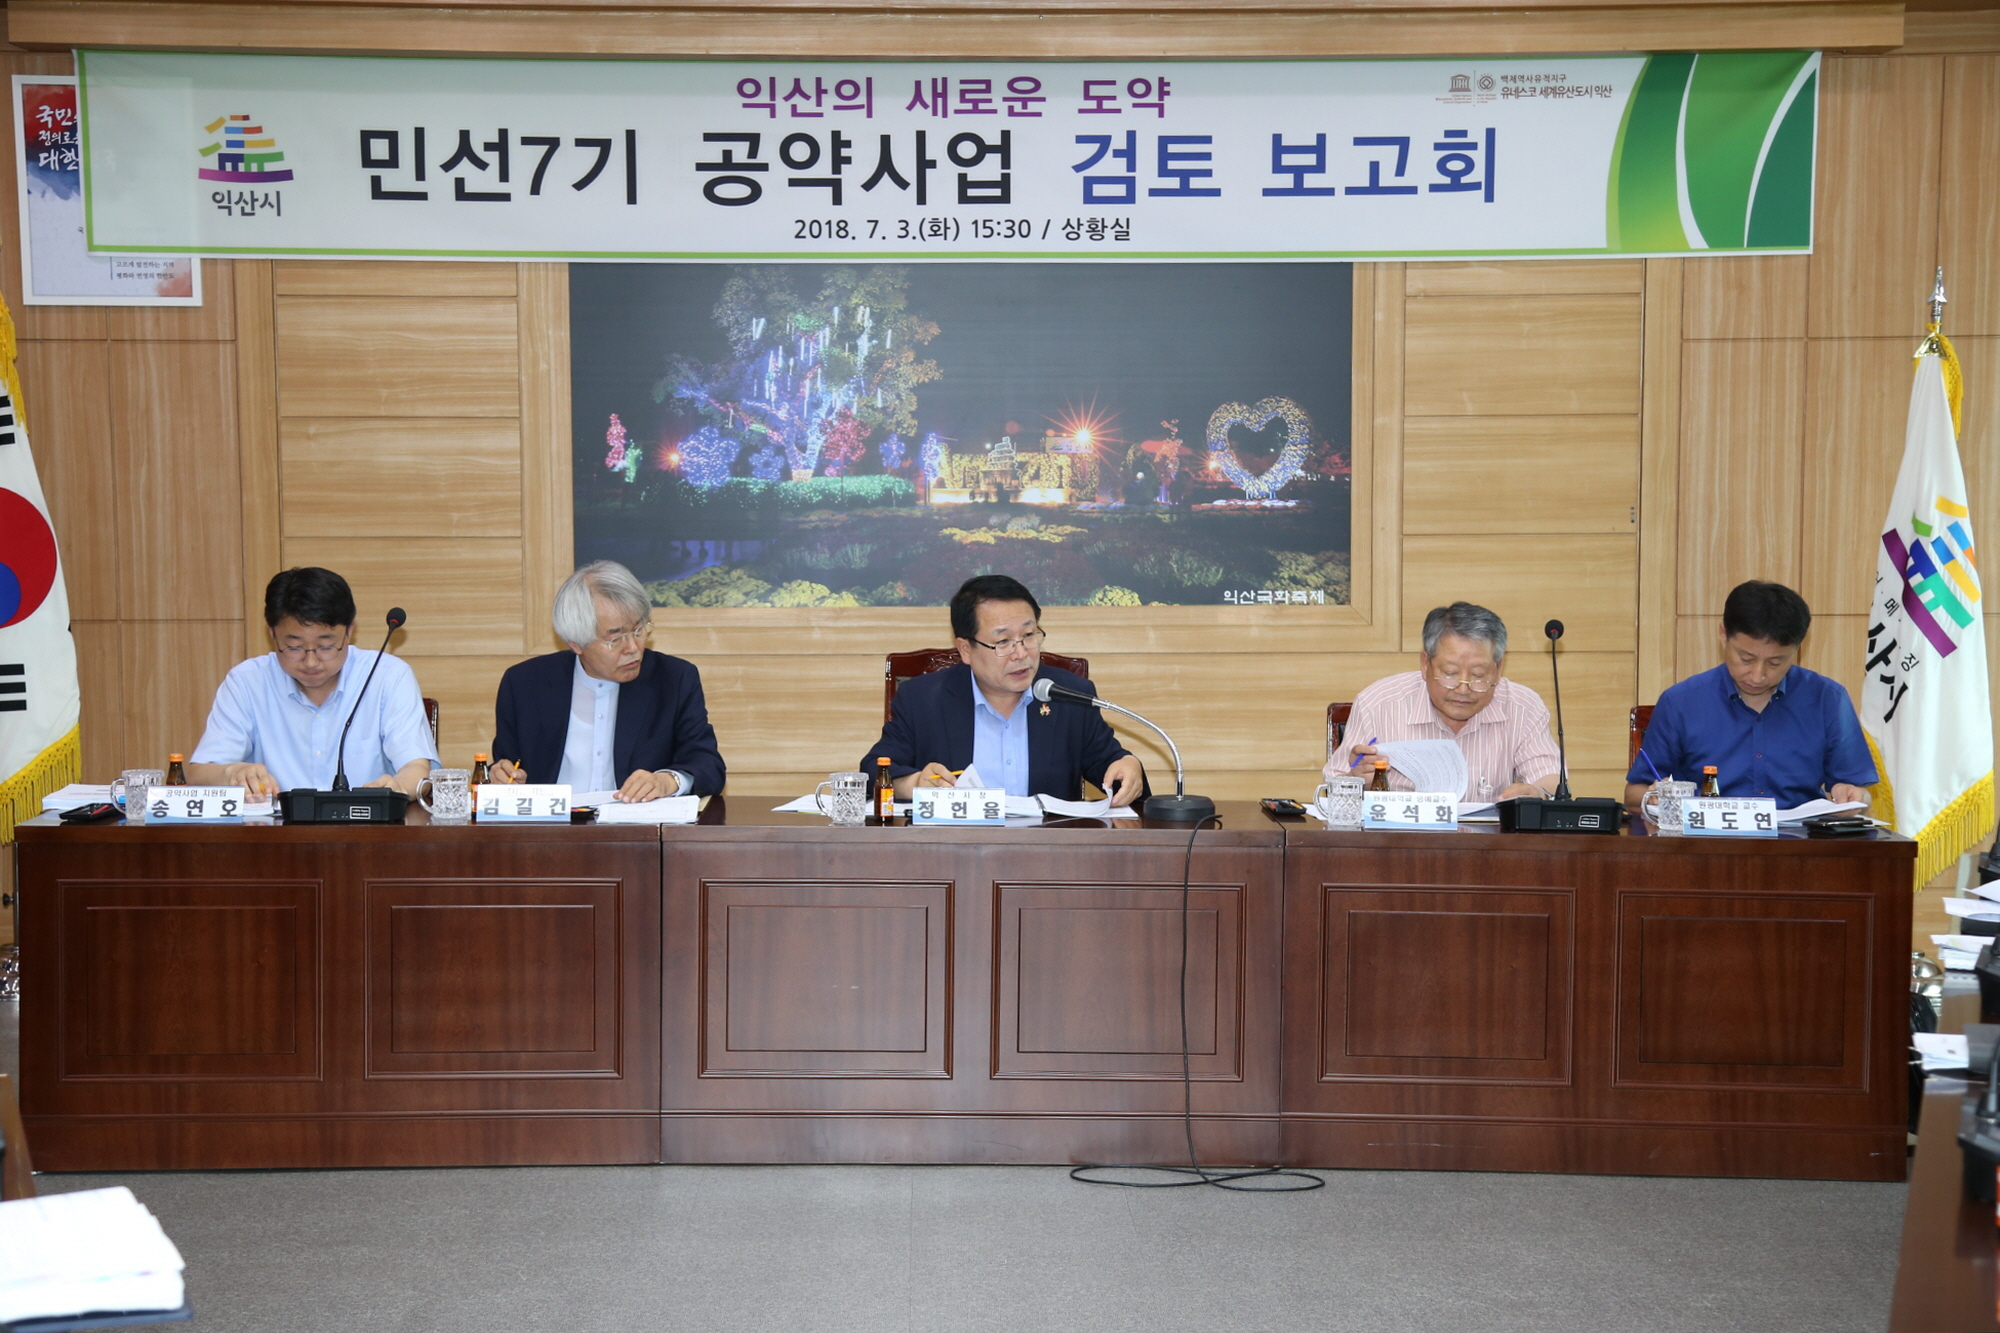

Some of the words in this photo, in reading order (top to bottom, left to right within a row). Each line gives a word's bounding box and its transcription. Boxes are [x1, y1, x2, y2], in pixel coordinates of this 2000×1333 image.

[736, 76, 873, 119] 익산의
[906, 76, 1047, 118] 새로운
[1078, 76, 1171, 118] 도약
[1501, 86, 1537, 99] 유네스코
[359, 127, 638, 205] 민선7기
[695, 130, 1011, 206] 공약사업
[1071, 130, 1221, 204] 검토
[1262, 128, 1496, 203] 보고회
[211, 190, 281, 217] 익산시
[794, 219, 856, 241] 2018.
[866, 219, 886, 241] 7.
[897, 217, 960, 242] 3.(화)
[971, 219, 1031, 239] 15:30
[1041, 219, 1051, 241] /
[1061, 217, 1131, 242] 상황실
[1224, 590, 1324, 604] 익산국화축제
[166, 789, 198, 797] 공약사업
